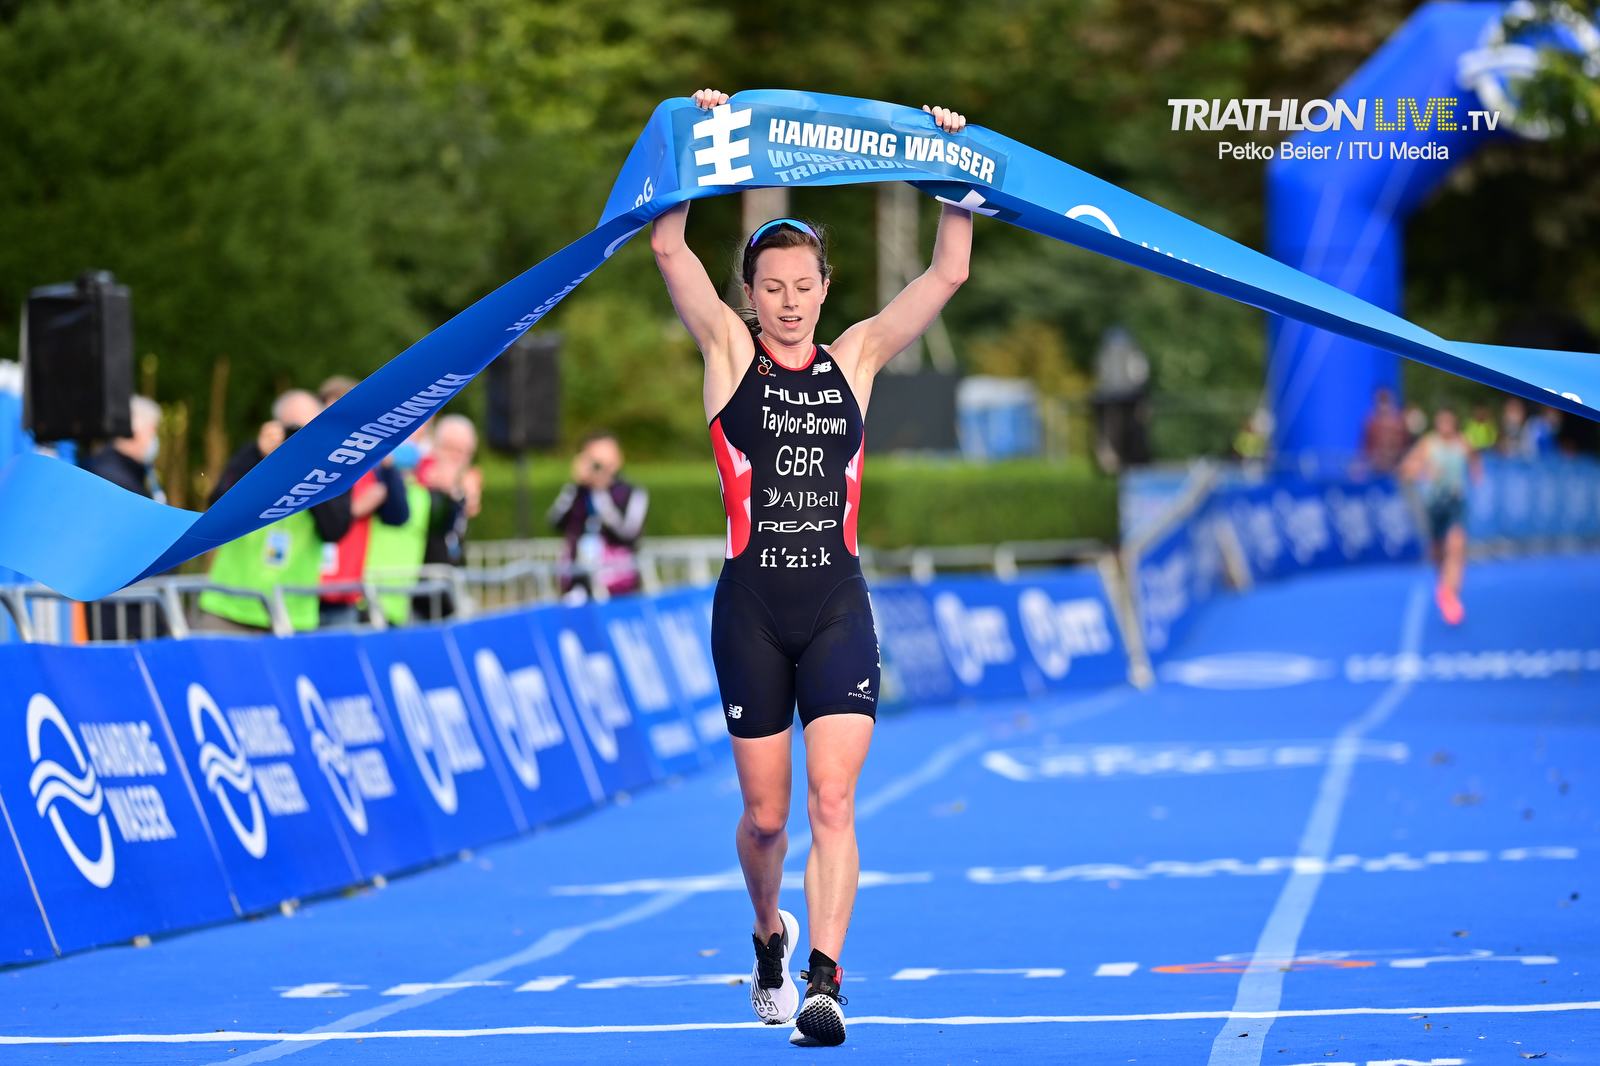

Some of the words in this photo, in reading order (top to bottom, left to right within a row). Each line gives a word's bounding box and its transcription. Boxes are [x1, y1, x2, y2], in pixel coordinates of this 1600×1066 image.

[768, 118, 897, 158] HAMBURG
[904, 135, 996, 184] WASSER
[764, 384, 843, 405] HUUB
[327, 373, 476, 465] HAMBURG
[762, 406, 847, 438] Taylor-Brown
[775, 445, 825, 477] GBR
[259, 469, 342, 519] 2020
[758, 520, 837, 533] REAP
